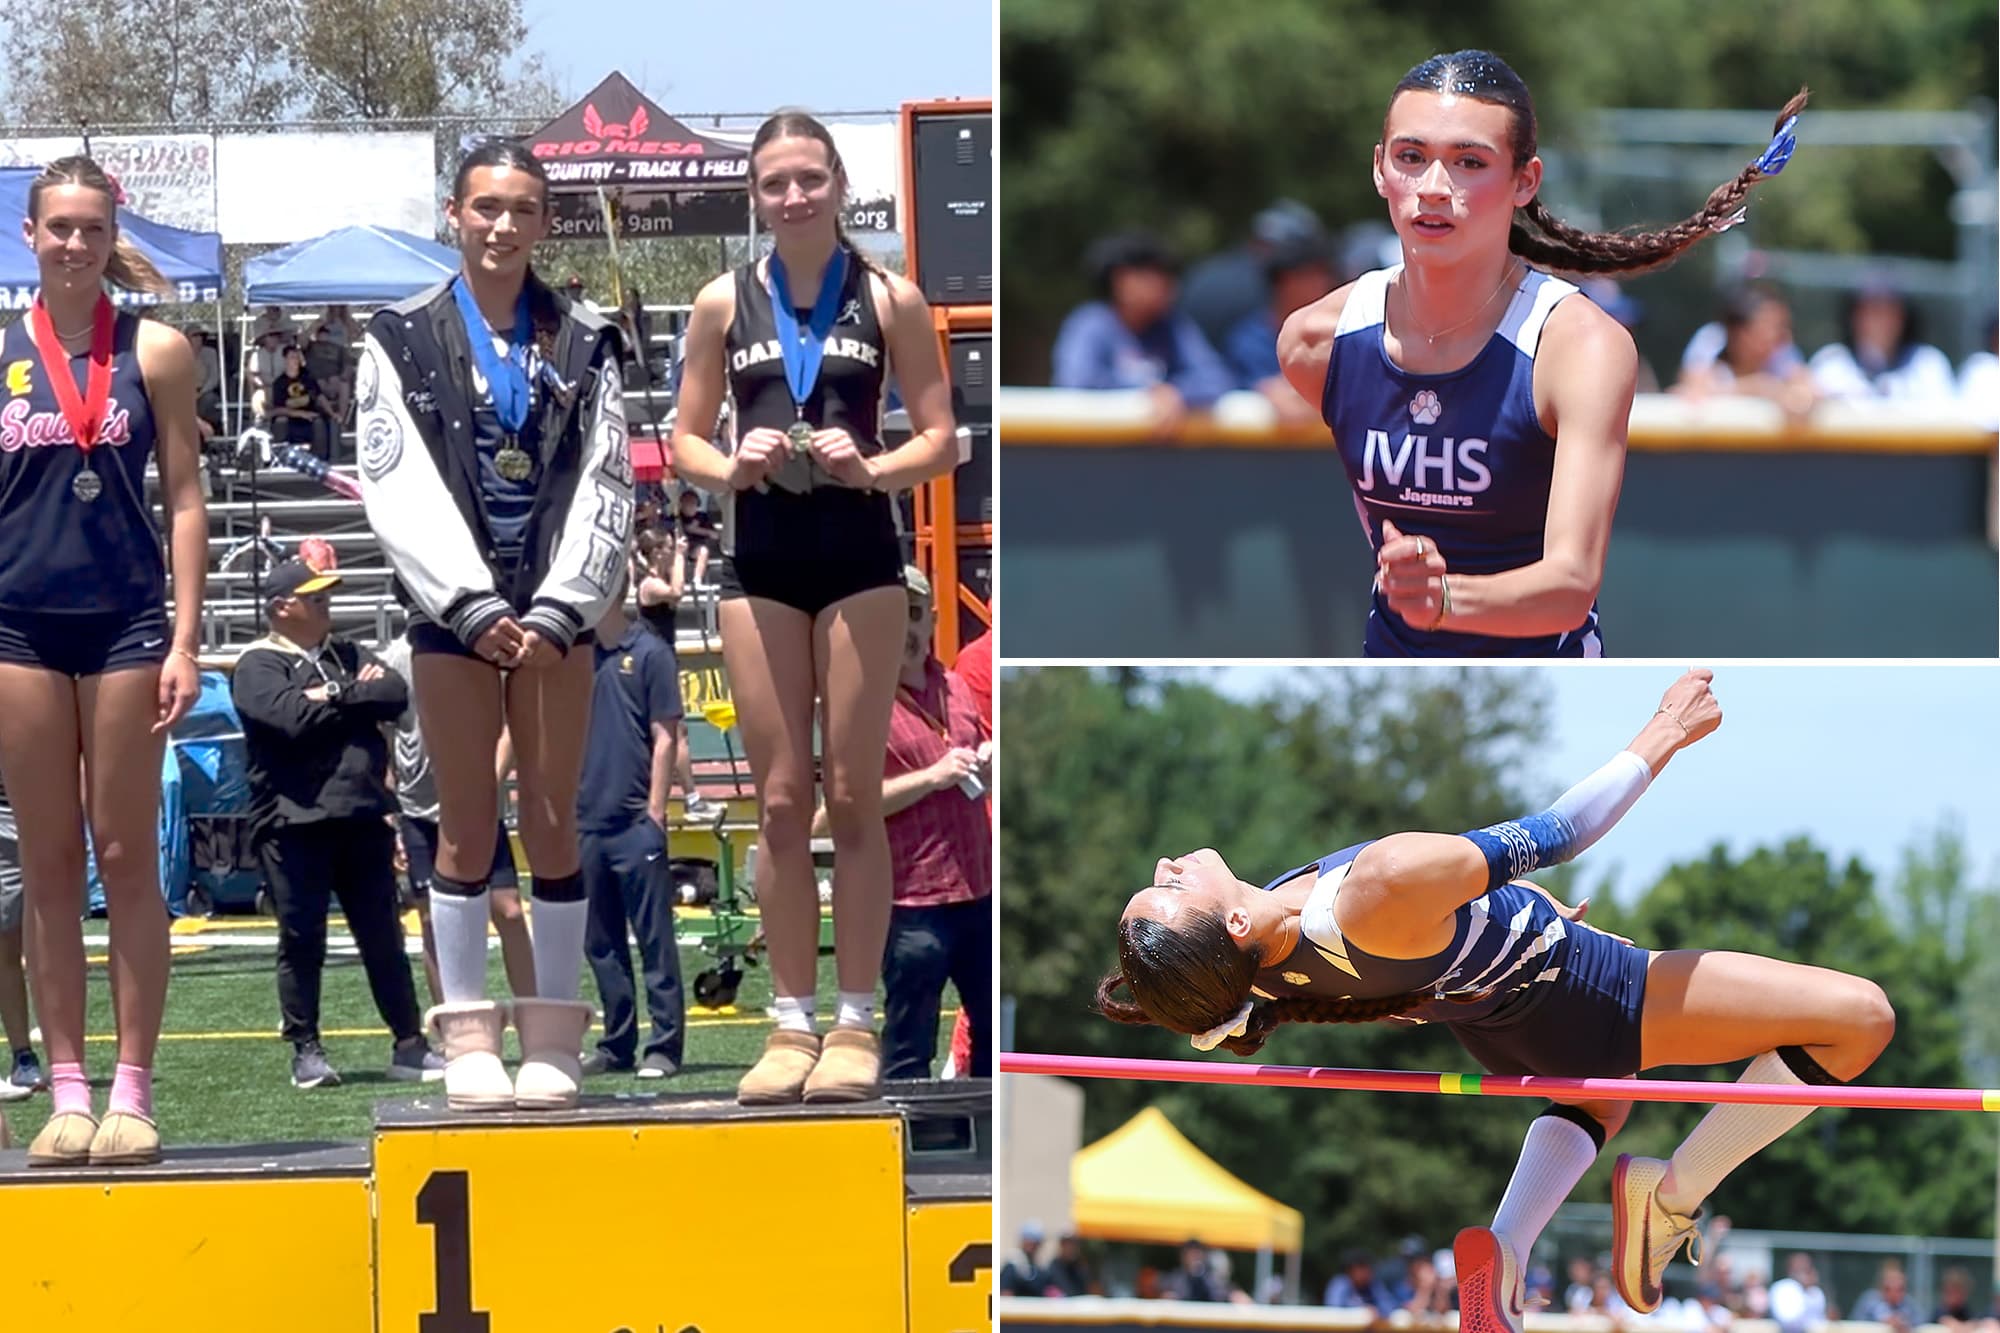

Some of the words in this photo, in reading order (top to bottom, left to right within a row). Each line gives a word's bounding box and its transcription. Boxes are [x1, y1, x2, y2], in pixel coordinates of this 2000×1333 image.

[531, 140, 601, 157] RIO
[604, 139, 704, 155] MESA
[628, 159, 682, 178] TRACK
[685, 160, 699, 177] &
[703, 159, 750, 176] FIELD
[551, 216, 621, 234] Servi
[628, 214, 673, 232] 9am
[800, 336, 879, 367] ARK
[1357, 429, 1492, 492] JVHS
[1399, 487, 1474, 506] Jaguars
[416, 1171, 490, 1333] 1
